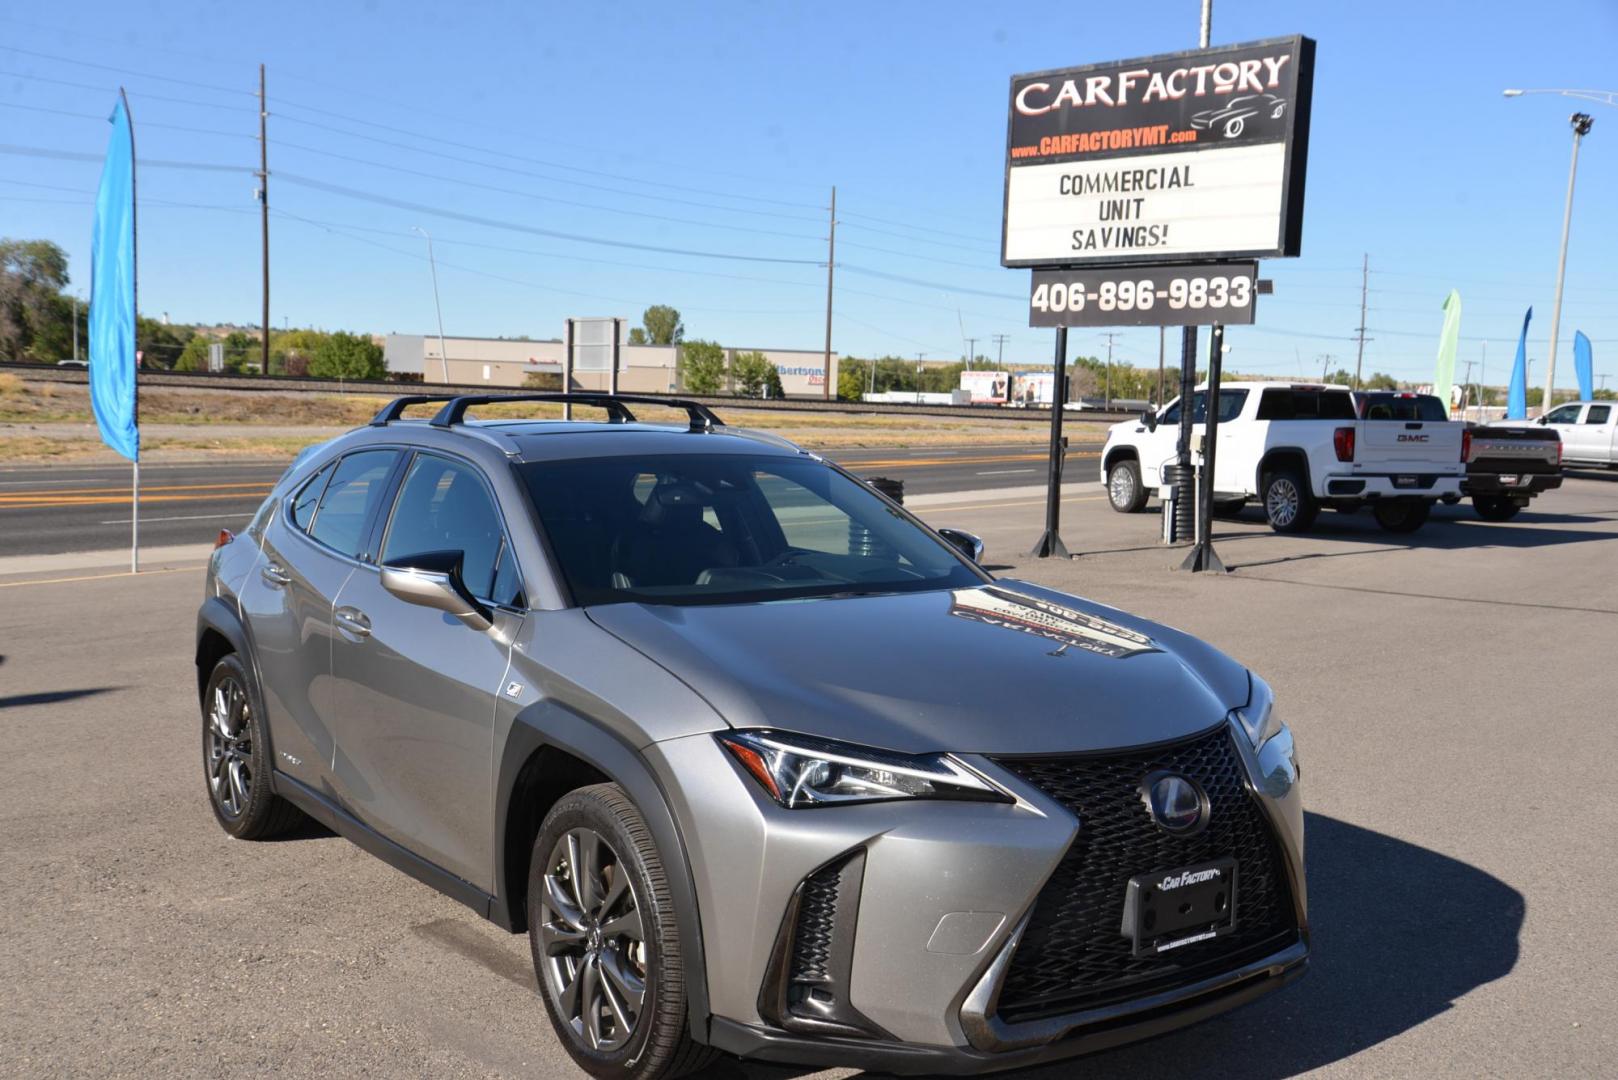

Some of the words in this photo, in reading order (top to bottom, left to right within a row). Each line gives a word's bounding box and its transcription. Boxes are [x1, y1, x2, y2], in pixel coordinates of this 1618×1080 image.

[1011, 124, 1197, 158] www.CARFACTORYMT.com
[1059, 165, 1195, 196] COMMERCIAL
[1099, 198, 1145, 221] UNIT
[1071, 224, 1169, 250] SAVINGS!
[1031, 275, 1251, 312] 406-896-9833
[1396, 434, 1430, 443] GMC
